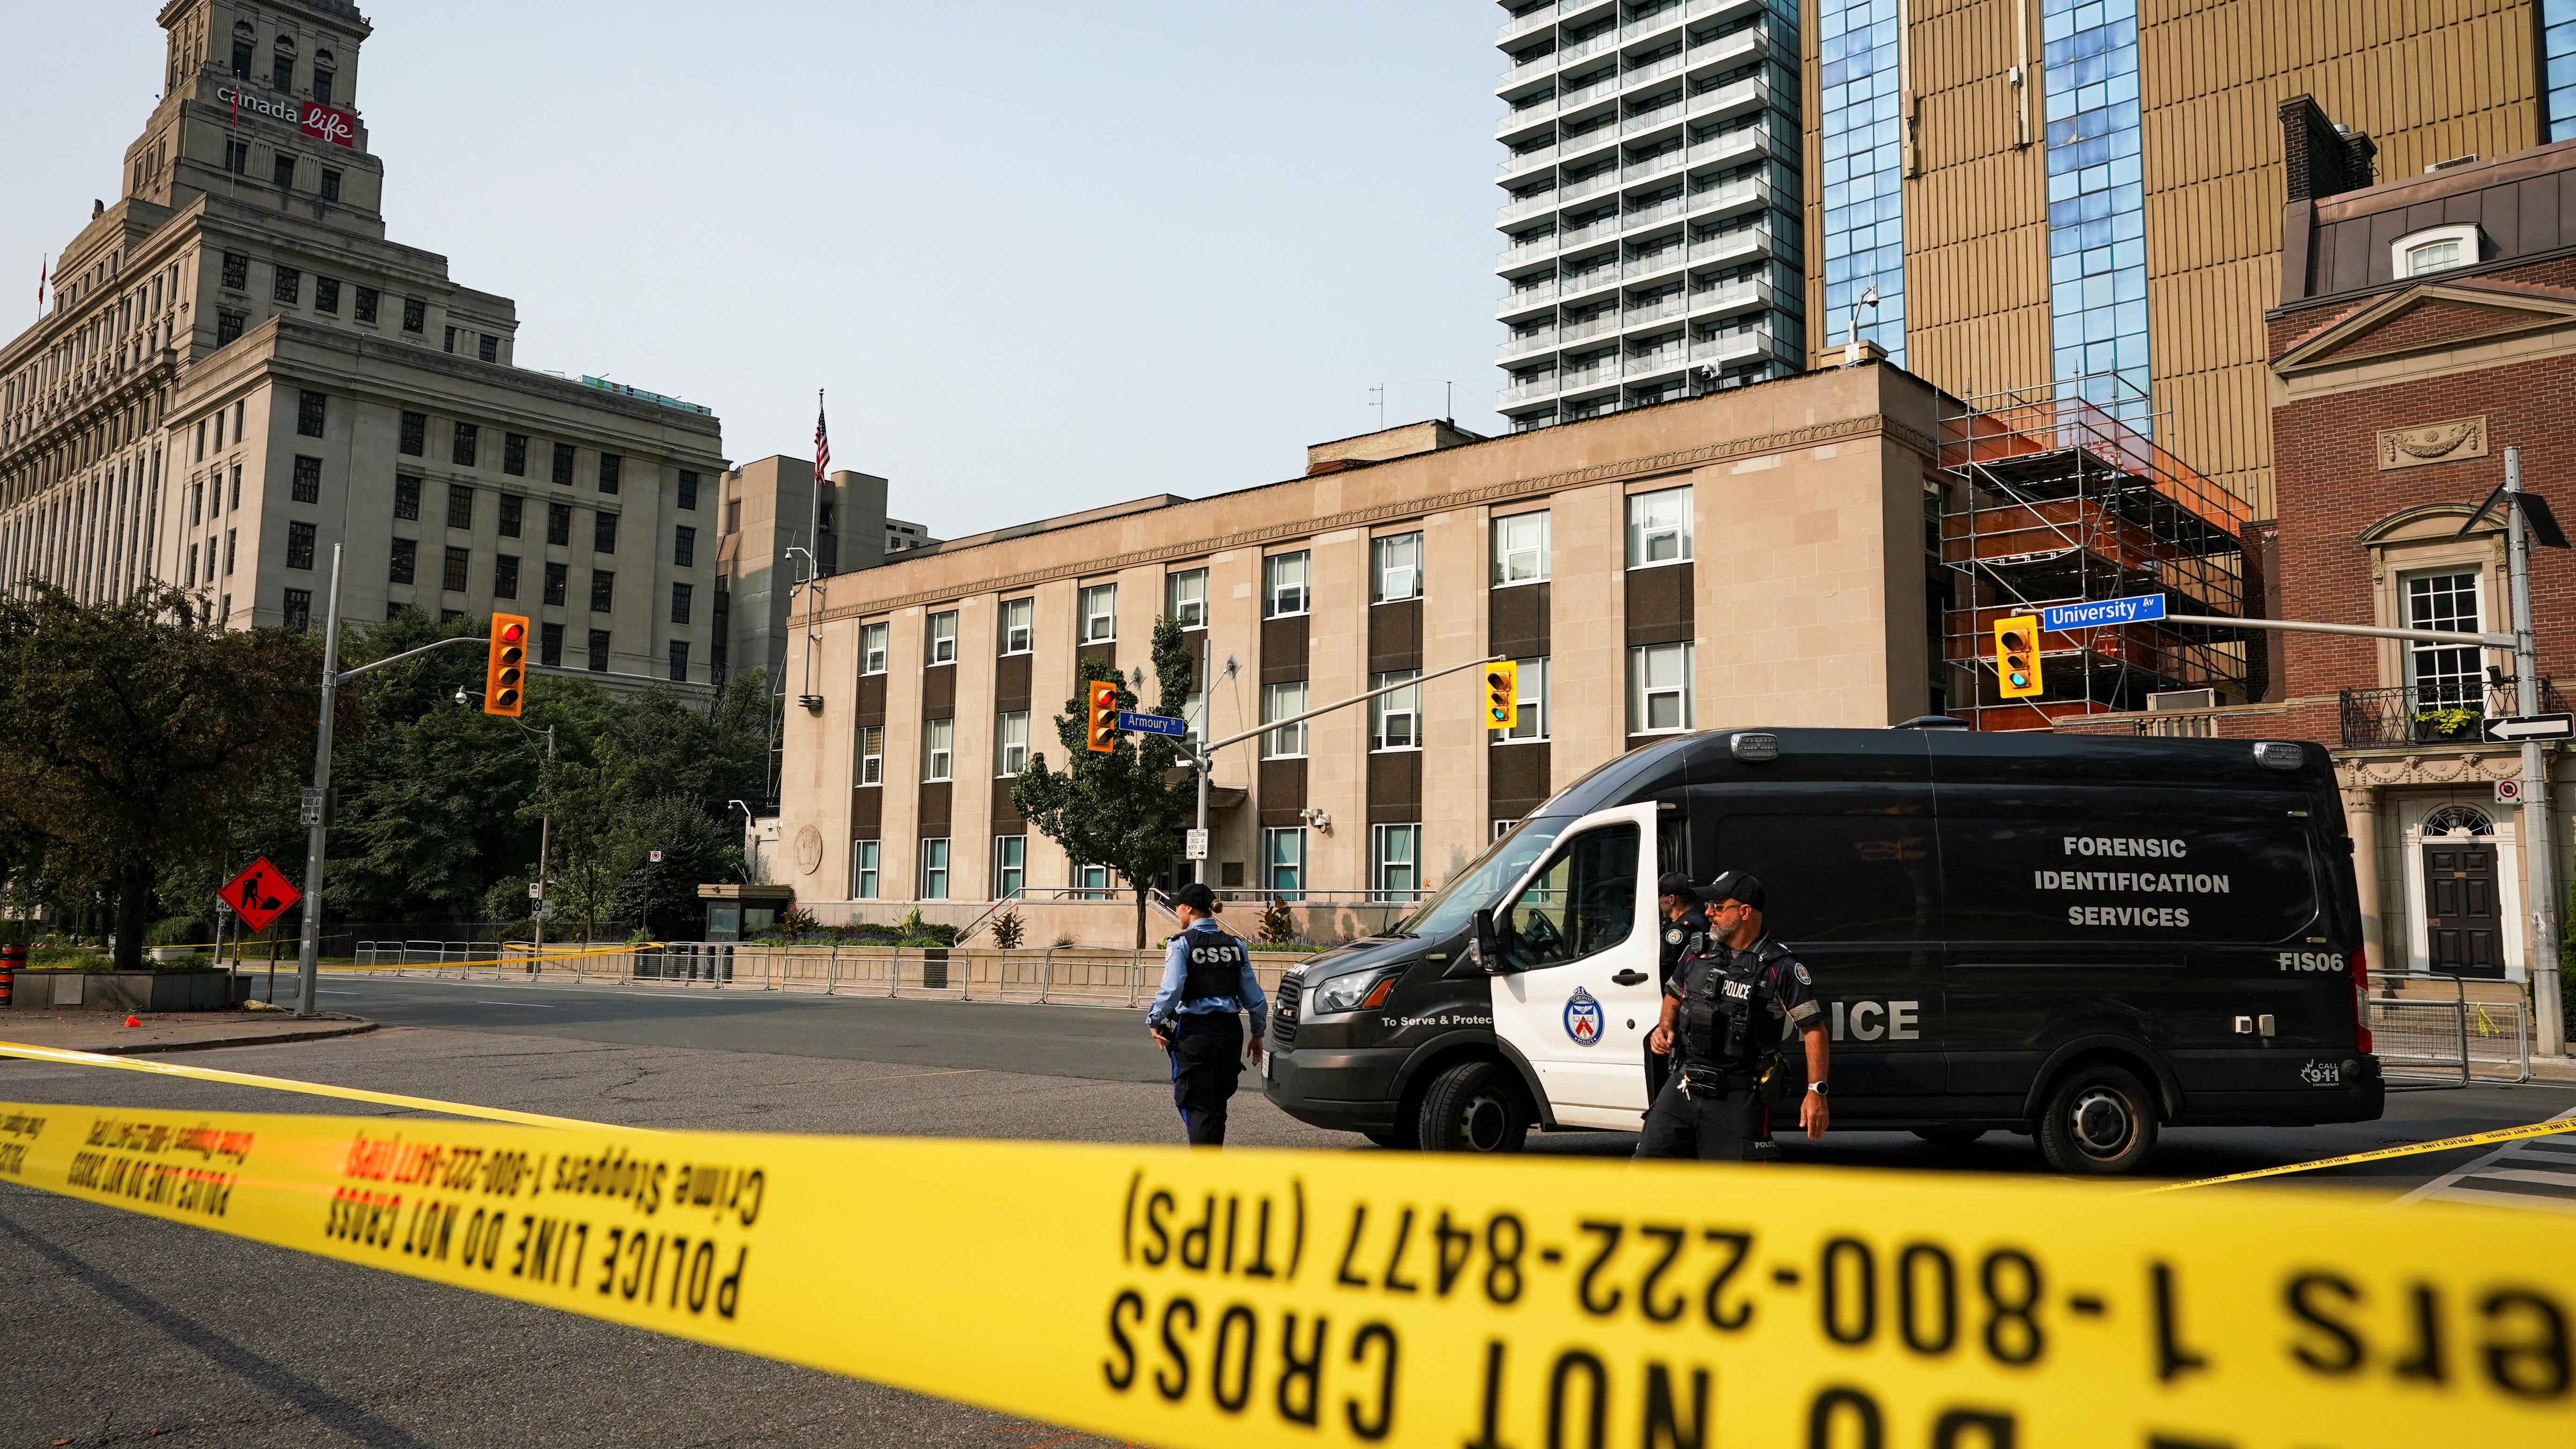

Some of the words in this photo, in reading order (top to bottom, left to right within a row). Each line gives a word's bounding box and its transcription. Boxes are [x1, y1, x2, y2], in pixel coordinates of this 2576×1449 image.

[217, 87, 297, 123] canada
[302, 108, 353, 142] life
[2052, 601, 2137, 624] University
[2143, 598, 2154, 606] Av
[1128, 714, 1168, 732] Armoury
[2064, 837, 2187, 858] FORENSIC
[2035, 871, 2229, 893] IDENTIFICATION
[2068, 906, 2190, 927] SERVICES
[1192, 946, 1241, 964] CSST
[2280, 953, 2344, 971] FIS06
[1571, 995, 1594, 1004] TORONTO
[1721, 980, 1751, 1000] POLICE
[1382, 1017, 1397, 1027] To
[1400, 1017, 1436, 1026] Serve
[1439, 1015, 1449, 1025] &
[1782, 1001, 1919, 1042] ICE
[2310, 1069, 2339, 1082] 9-1-1
[2442, 1137, 2474, 1146] POLICE
[554, 1145, 666, 1215] Stoppers
[674, 1164, 765, 1227] Crime
[404, 1199, 462, 1262] NOT
[1124, 1169, 1305, 1281] (TIPS)
[463, 1206, 507, 1271] DO
[511, 1215, 589, 1290] LINE
[598, 1227, 750, 1320] POLICE
[1103, 1290, 1399, 1442] CROSS
[1463, 1339, 1713, 1449] NOT
